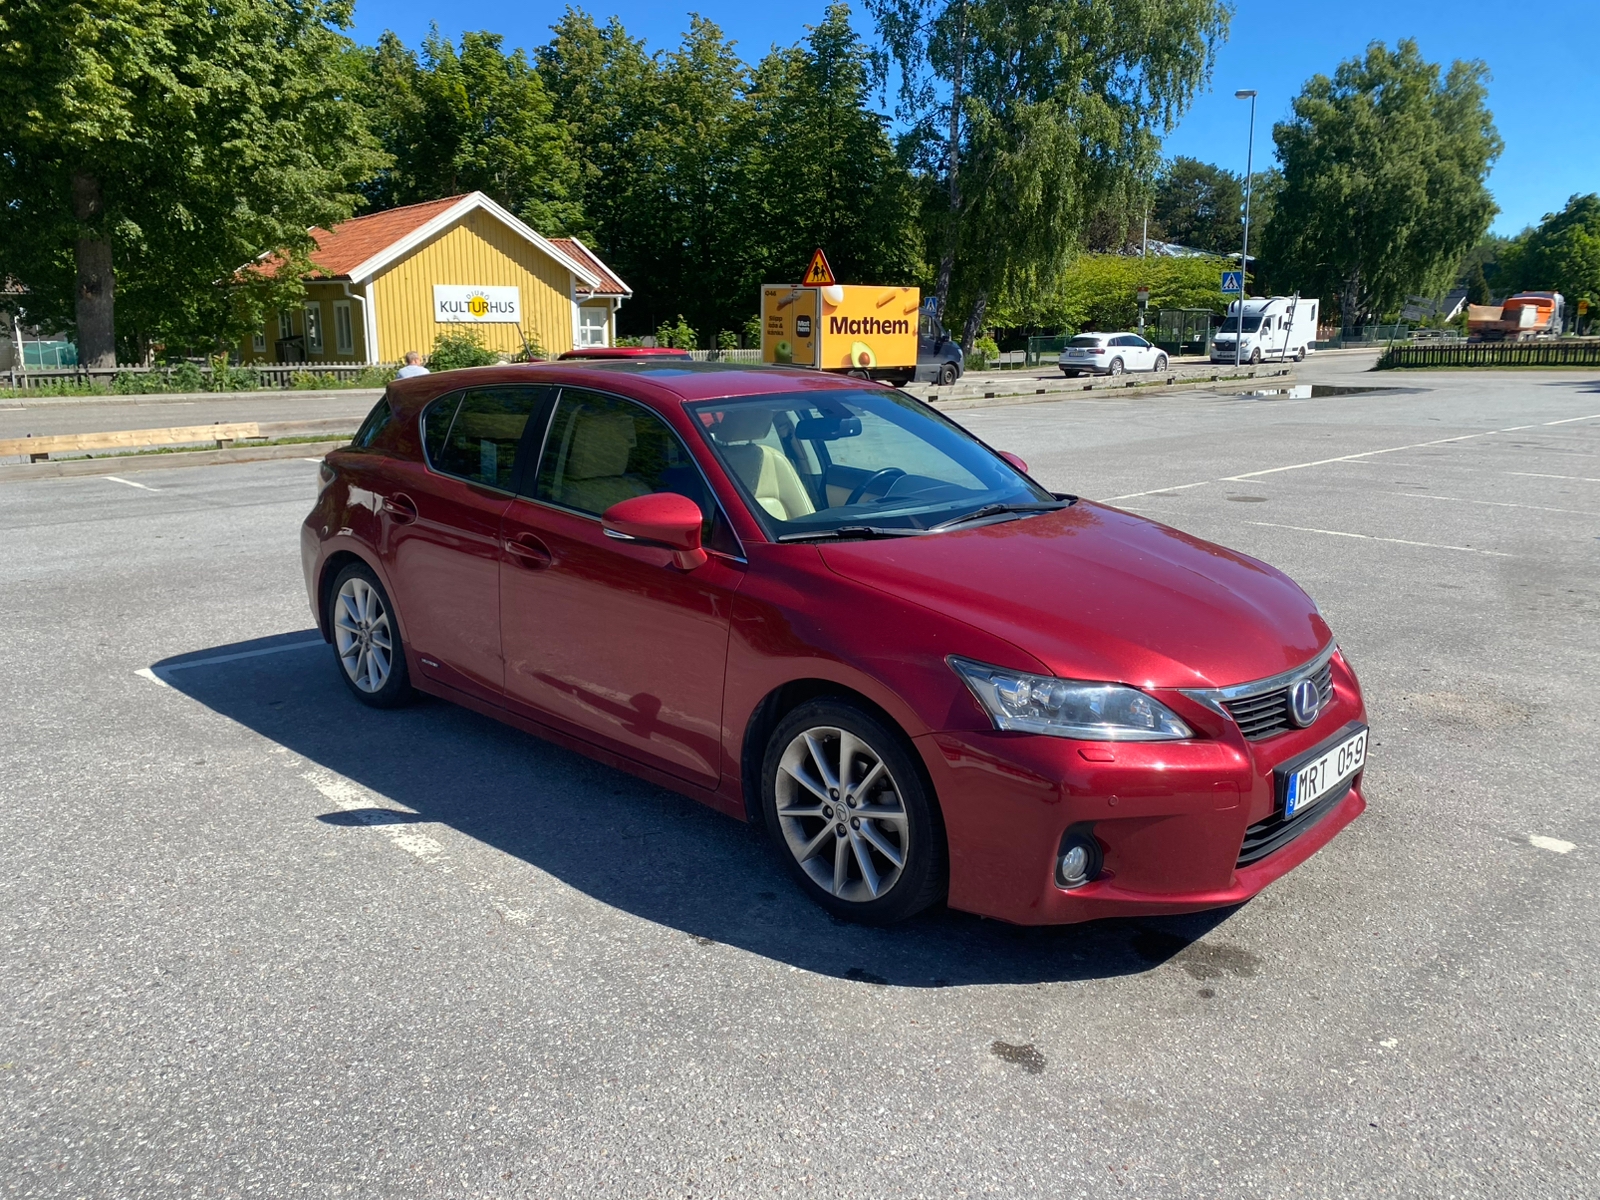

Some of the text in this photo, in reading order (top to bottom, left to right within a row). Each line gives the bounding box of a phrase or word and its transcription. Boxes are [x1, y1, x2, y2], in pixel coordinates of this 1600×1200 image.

[440, 300, 515, 313] KULTURHUS
[830, 316, 909, 335] Mathem
[1298, 735, 1364, 805] MRT 059
